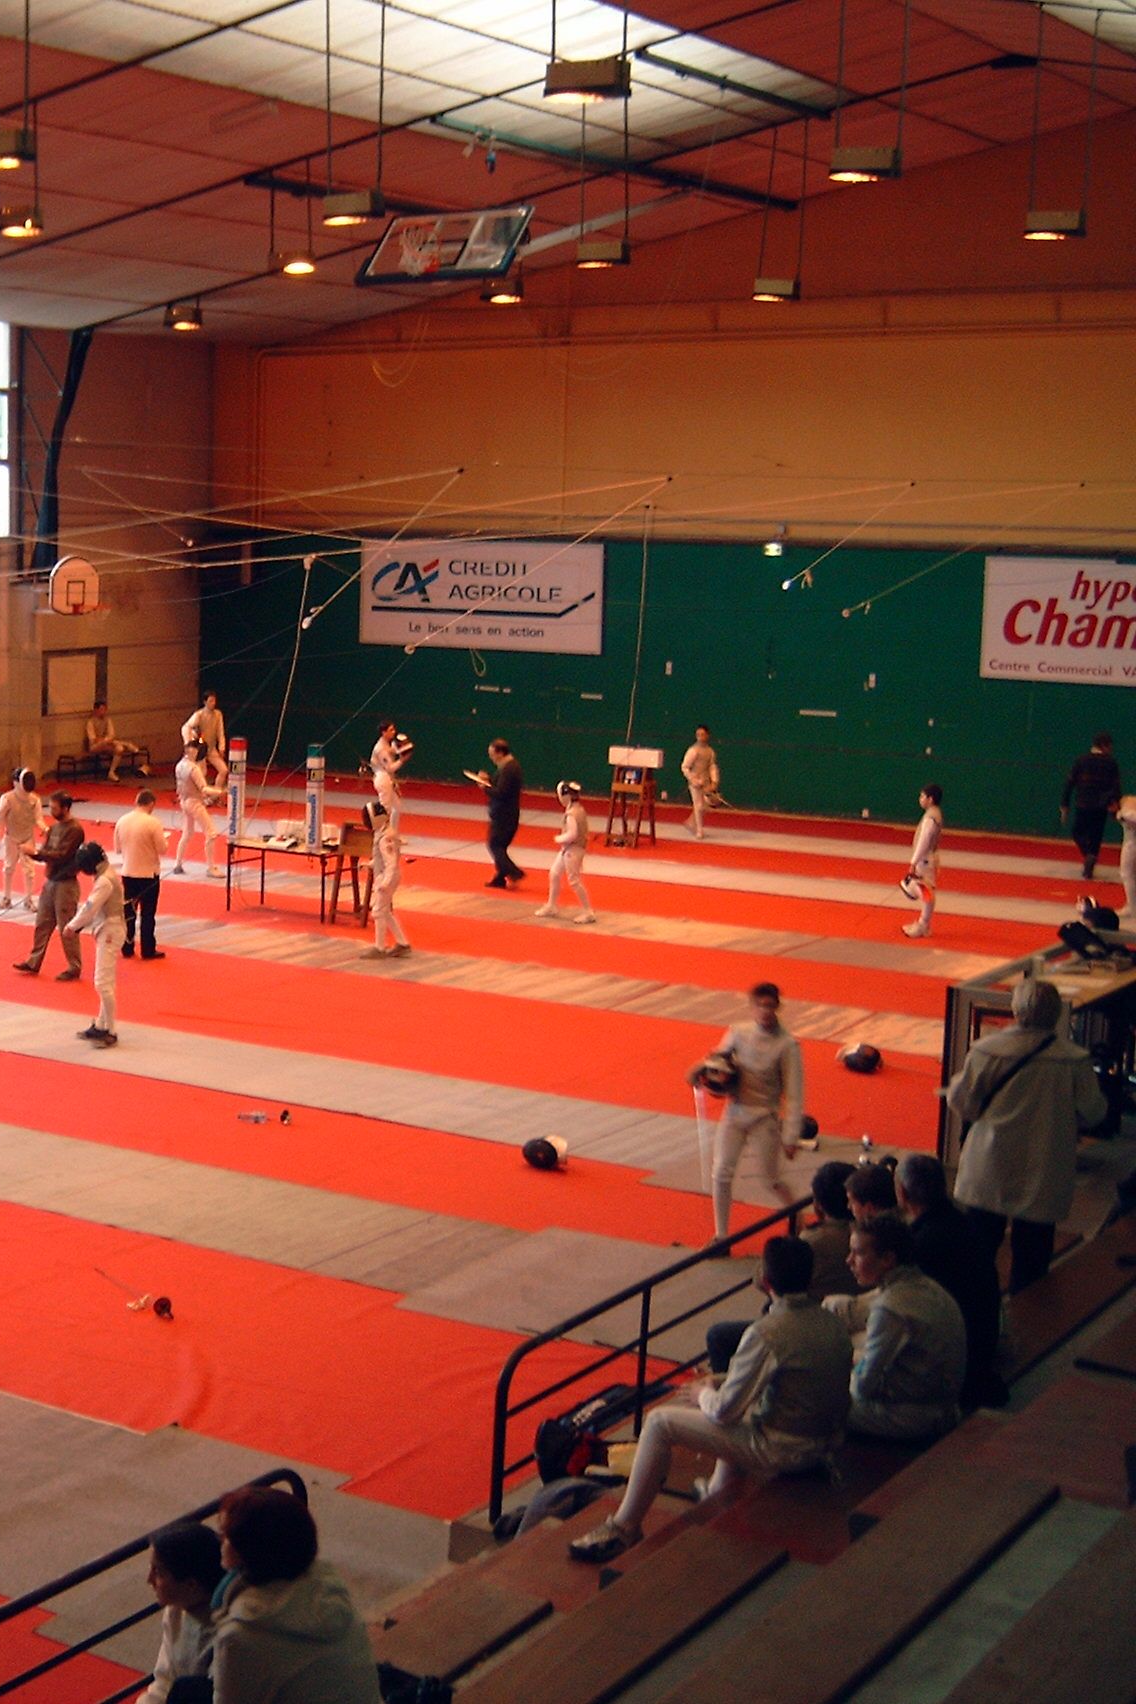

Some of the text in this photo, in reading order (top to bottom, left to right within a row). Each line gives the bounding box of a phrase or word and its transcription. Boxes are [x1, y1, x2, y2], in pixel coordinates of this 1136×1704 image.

[448, 560, 528, 577] CREDIT
[448, 584, 563, 604] AGRICOLE
[1070, 570, 1136, 611] hyp
[409, 622, 421, 632] Le
[456, 625, 481, 636] sens
[487, 626, 501, 636] en
[508, 625, 544, 638] action
[989, 659, 1030, 671] Centre
[1037, 661, 1113, 676] Commercial
